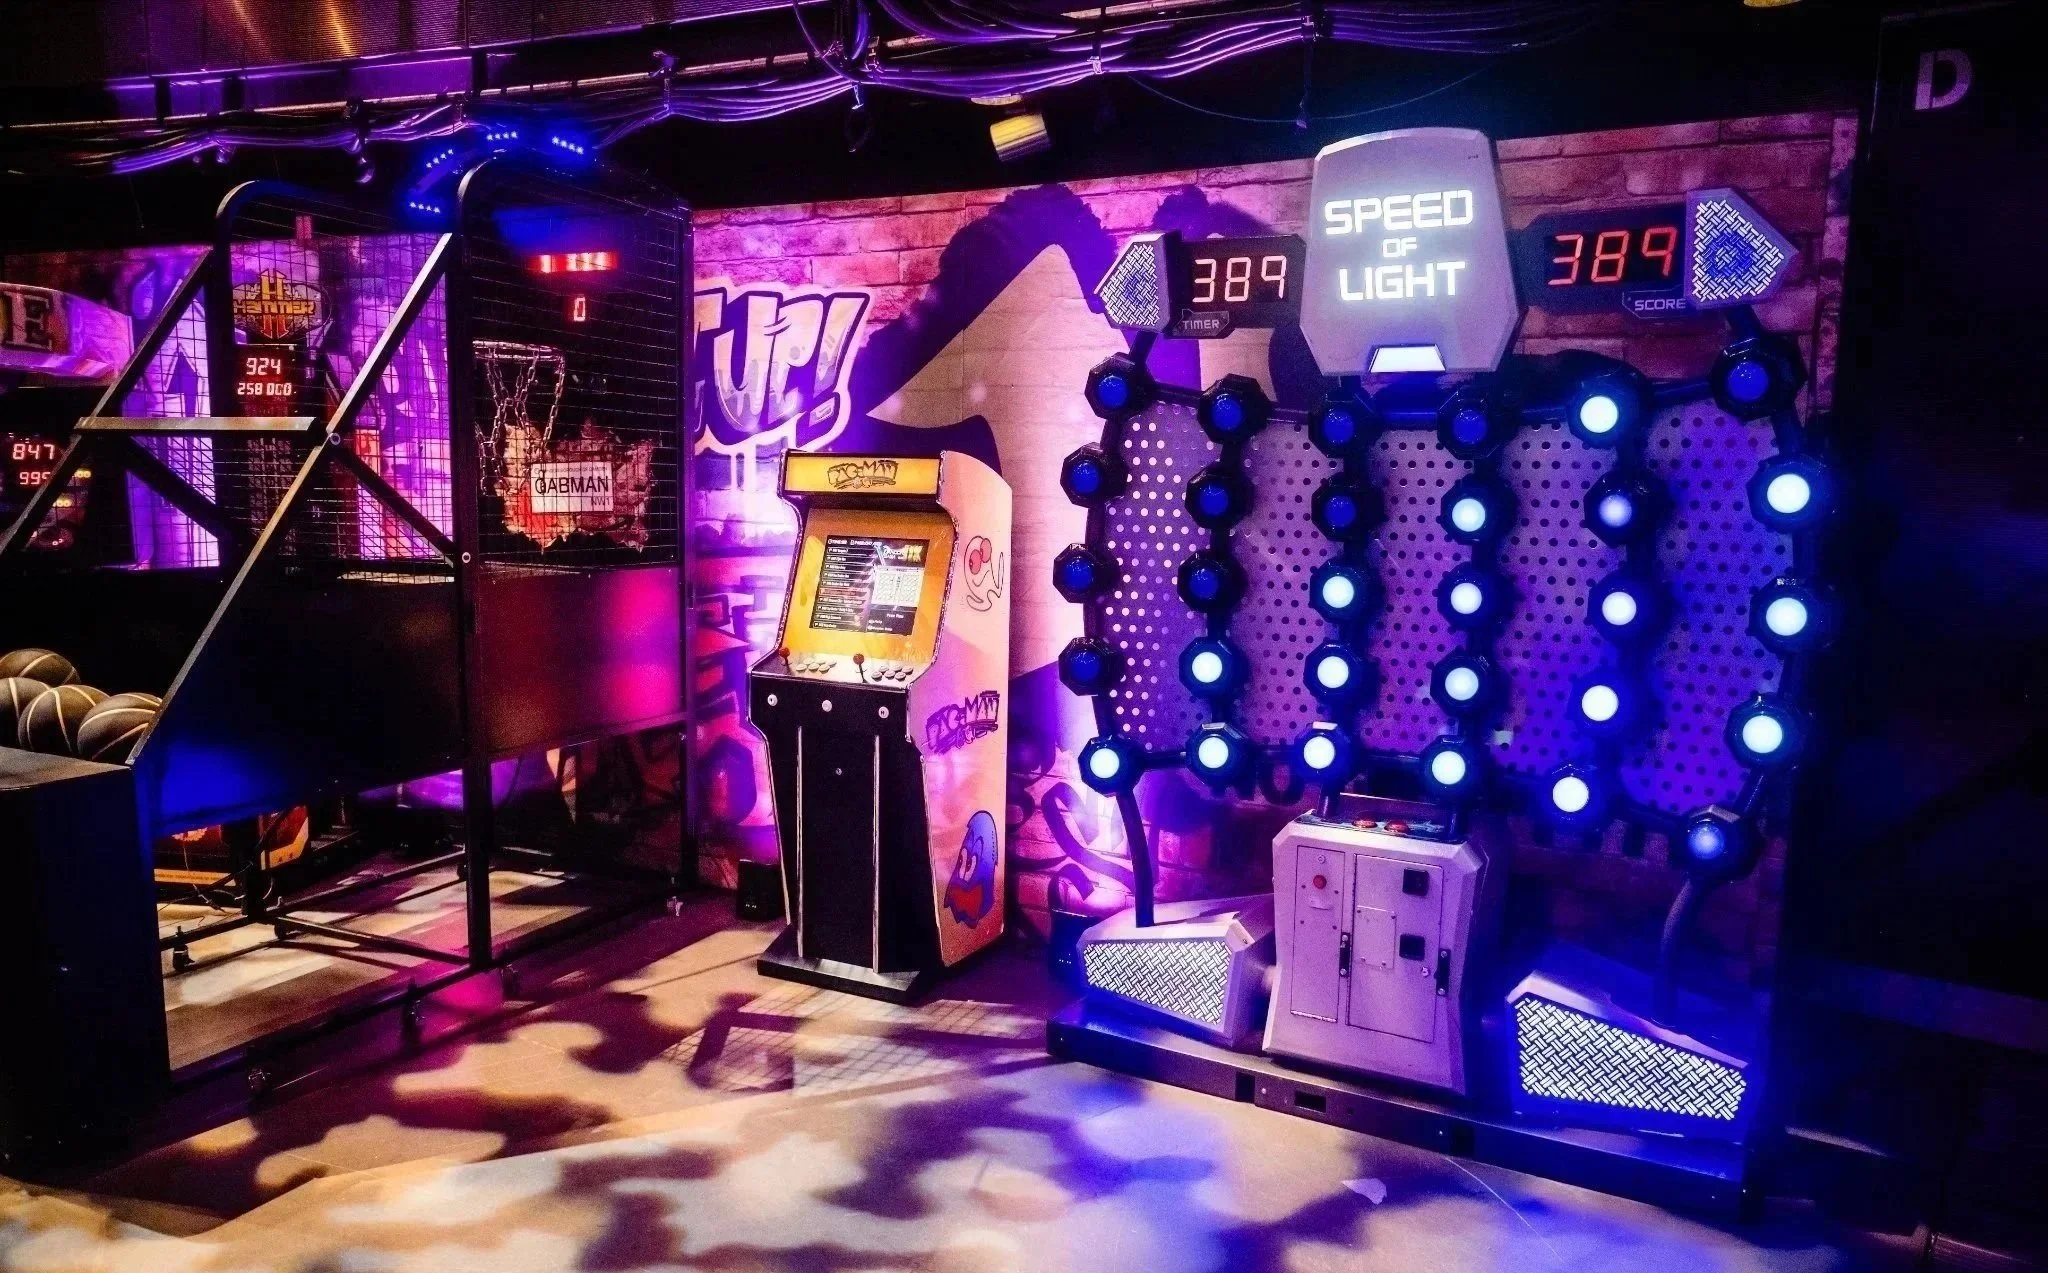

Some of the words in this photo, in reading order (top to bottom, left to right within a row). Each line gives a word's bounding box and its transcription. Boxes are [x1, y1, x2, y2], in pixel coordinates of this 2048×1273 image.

[1915, 49, 1970, 110] D
[1324, 189, 1474, 236] SPEED
[1382, 236, 1418, 258] OF
[1547, 226, 1679, 286] 389
[1191, 255, 1287, 303] 389
[1339, 261, 1466, 301] LIGHT
[1634, 298, 1687, 312] SCORE
[1182, 319, 1220, 331] TIMER
[246, 357, 281, 376] 924
[711, 291, 870, 440] UP!
[237, 382, 263, 395] 258
[12, 443, 55, 460] 847
